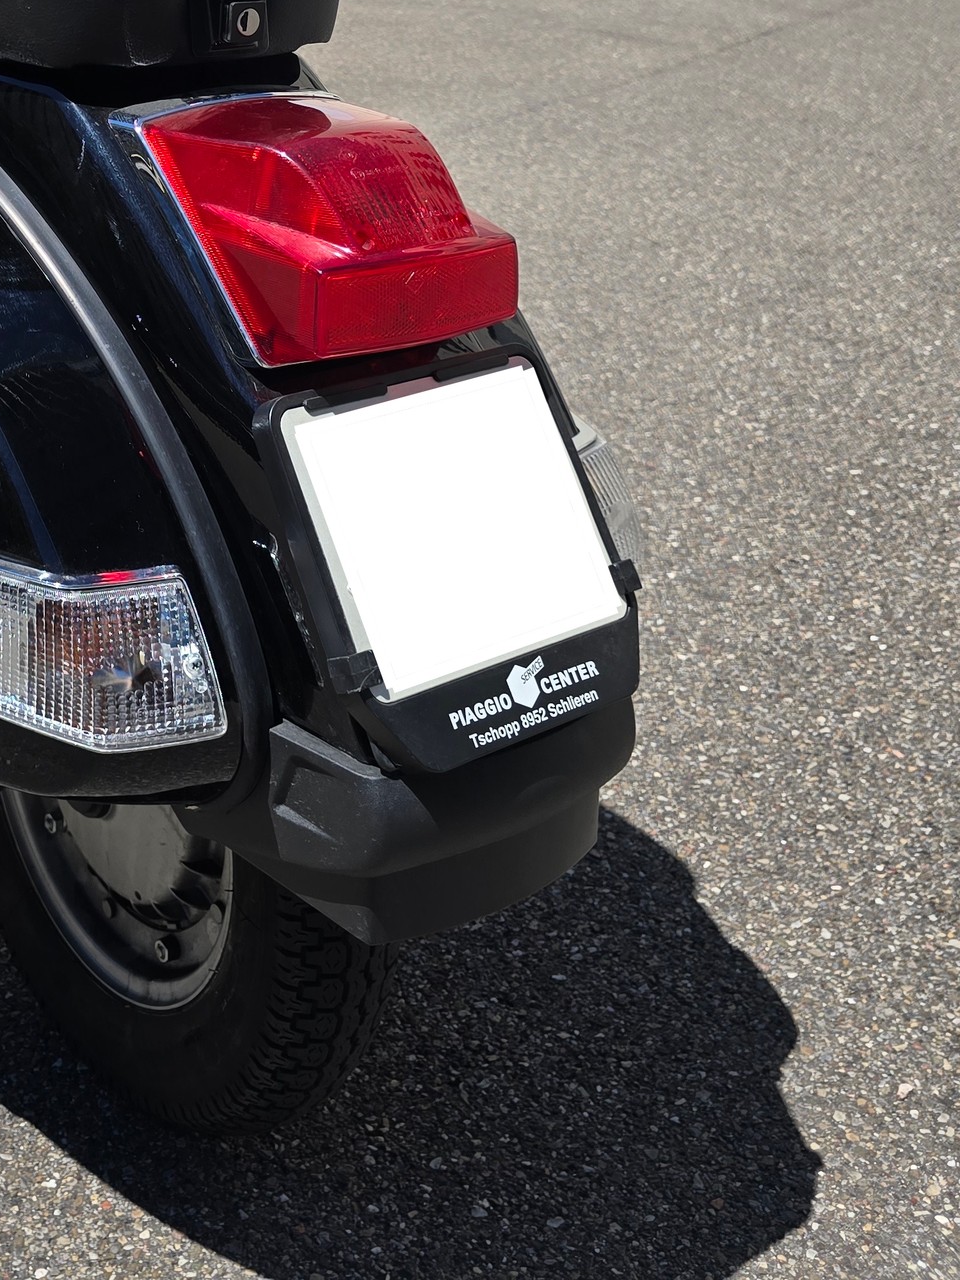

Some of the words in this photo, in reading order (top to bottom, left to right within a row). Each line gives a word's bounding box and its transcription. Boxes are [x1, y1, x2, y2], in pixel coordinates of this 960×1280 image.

[448, 693, 513, 730] PIAGGIO
[540, 660, 600, 694] CENTER
[520, 658, 543, 684] SERVICE
[468, 720, 521, 748] Tschopp
[520, 707, 549, 728] 8952
[548, 689, 600, 718] Schlieren
